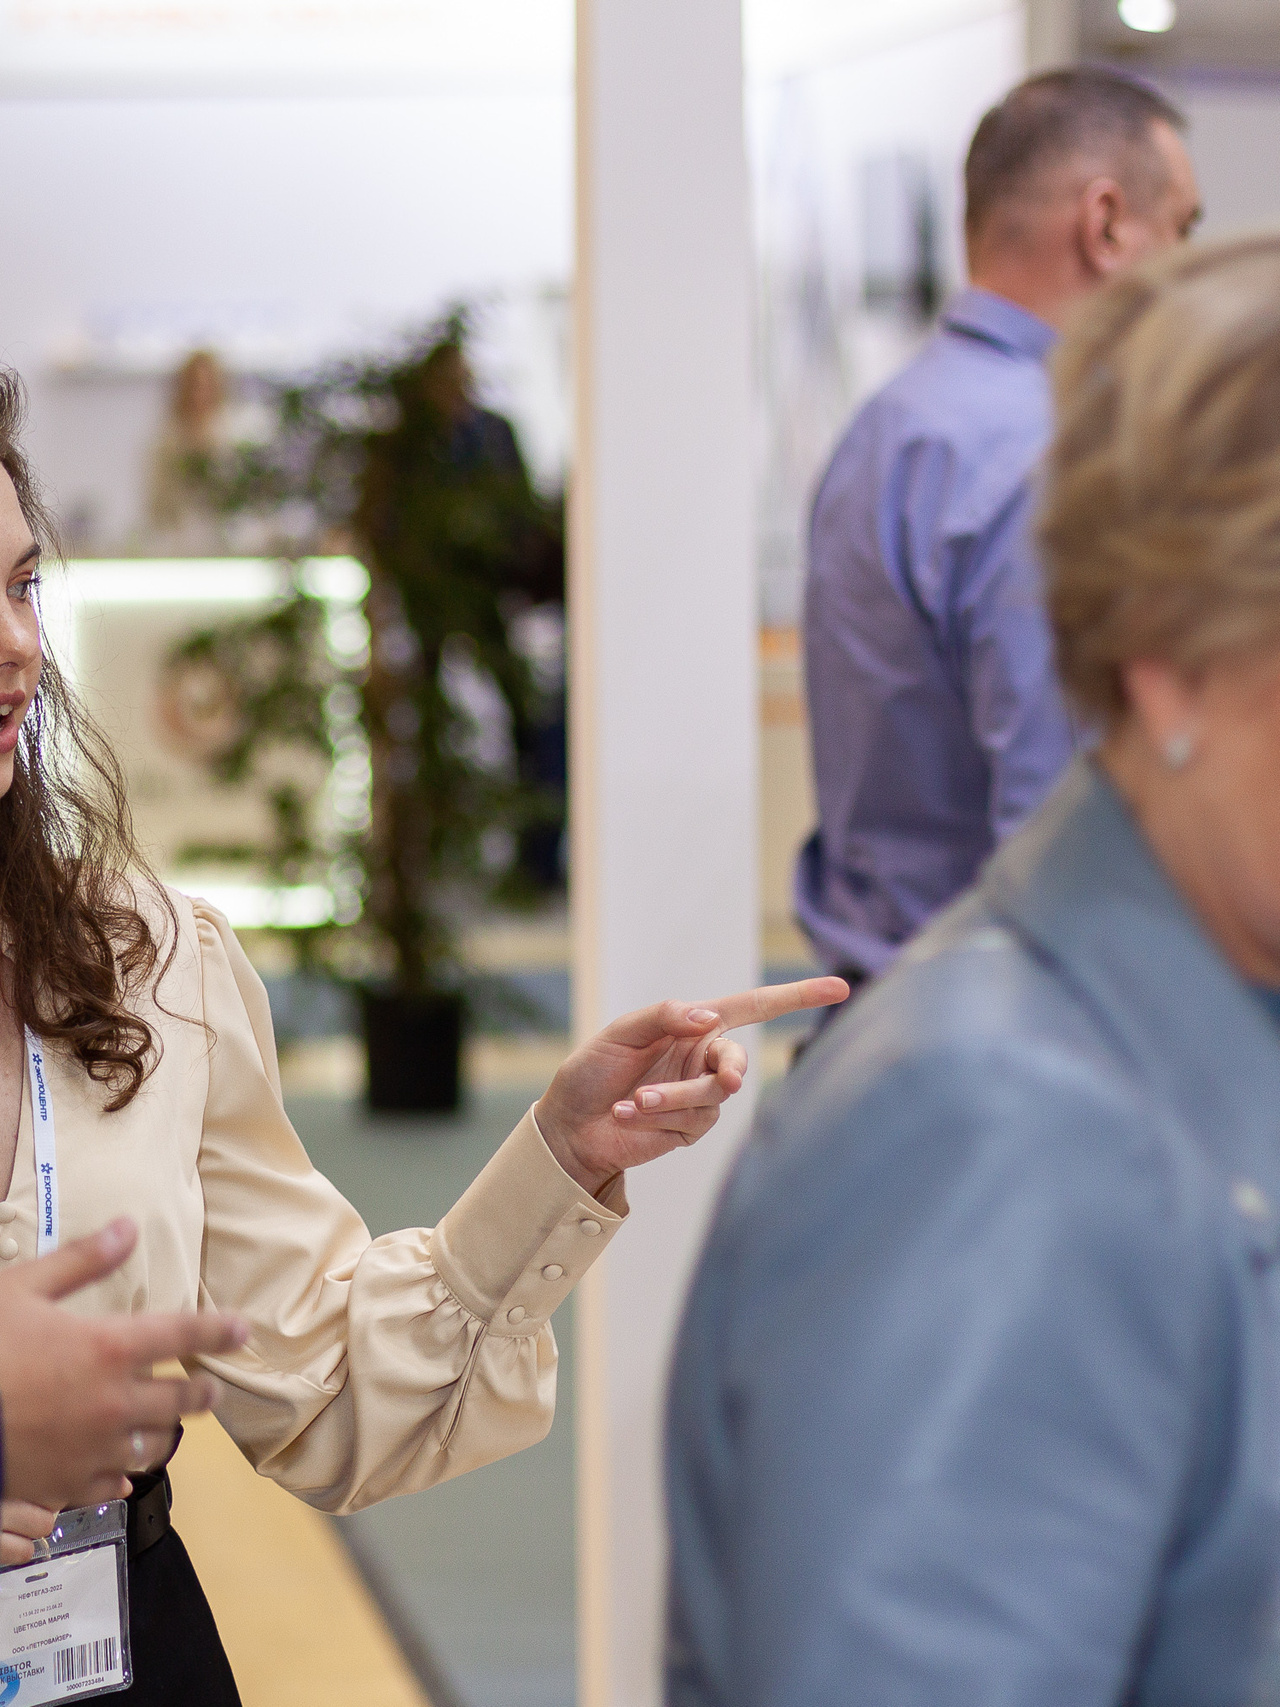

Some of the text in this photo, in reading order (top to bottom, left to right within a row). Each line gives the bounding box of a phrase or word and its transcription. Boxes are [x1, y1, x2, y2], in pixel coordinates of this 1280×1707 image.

[35, 1065, 48, 1121] ЭКСПОЦЕНТР
[43, 1175, 53, 1237] EXPOCENTRE
[18, 1584, 63, 1601] НЕФТЕГАЗ-2022
[13, 1612, 70, 1634] ЦВЕТКОВА МАРИЯ
[12, 1645, 26, 1654] ООО
[6, 1666, 45, 1683] ВЫСТАВКИ
